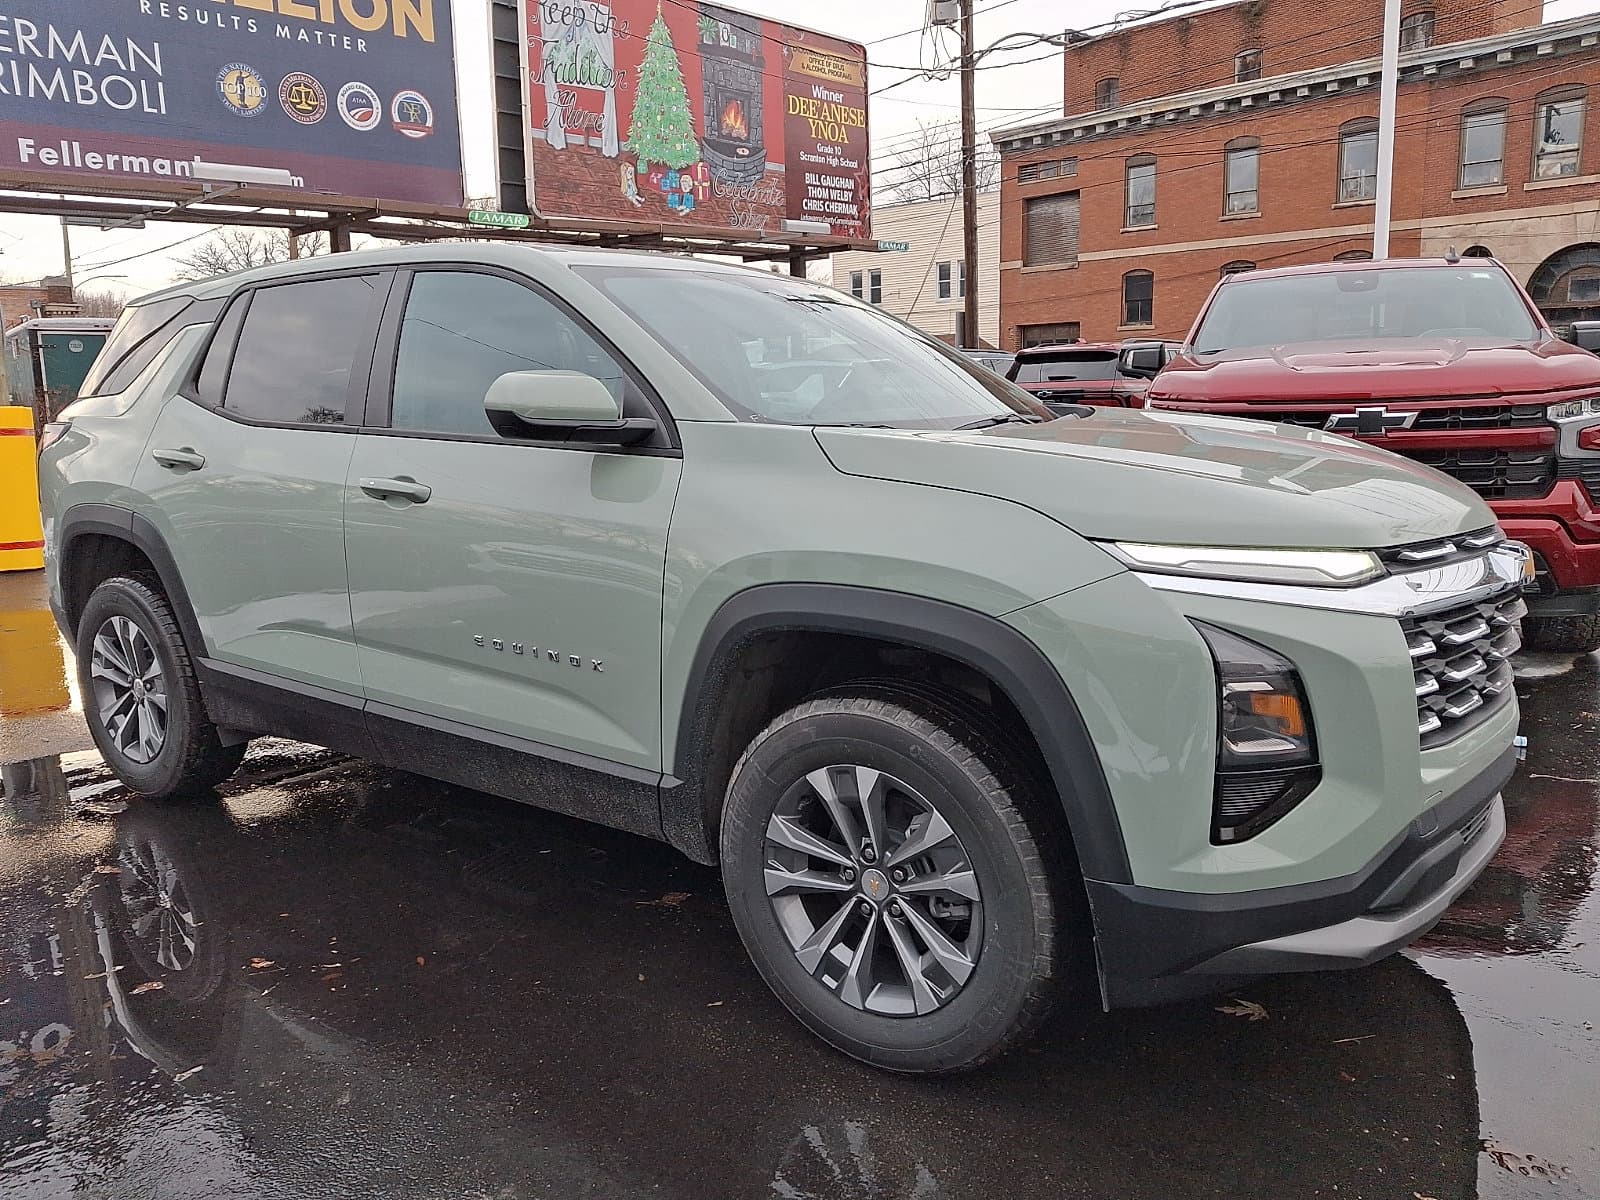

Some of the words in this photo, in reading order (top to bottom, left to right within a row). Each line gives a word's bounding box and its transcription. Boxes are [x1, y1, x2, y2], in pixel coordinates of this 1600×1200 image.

[140, 0, 258, 33] RESULTS
[275, 23, 368, 53] MATTER
[806, 64, 827, 75] ALCOHOL
[808, 56, 825, 68] OFFICE
[248, 86, 267, 98] 100
[812, 84, 844, 103] Winner
[788, 94, 866, 128] DEE'ANESE
[808, 118, 849, 143] YNOA
[816, 143, 834, 155] Grade
[834, 146, 842, 155] 10
[800, 151, 826, 164] Scranton
[826, 155, 840, 168] High
[840, 157, 858, 168] School
[804, 172, 821, 185] BILL
[820, 175, 855, 190] GAUGHAN
[807, 186, 829, 199] THOM
[829, 188, 853, 202] WELBY
[802, 199, 825, 211] CHRIS
[824, 202, 859, 216] CHERMAK
[474, 212, 522, 225] LAMAR
[880, 241, 906, 251] LAMAR
[473, 634, 603, 673] EQUINOX
